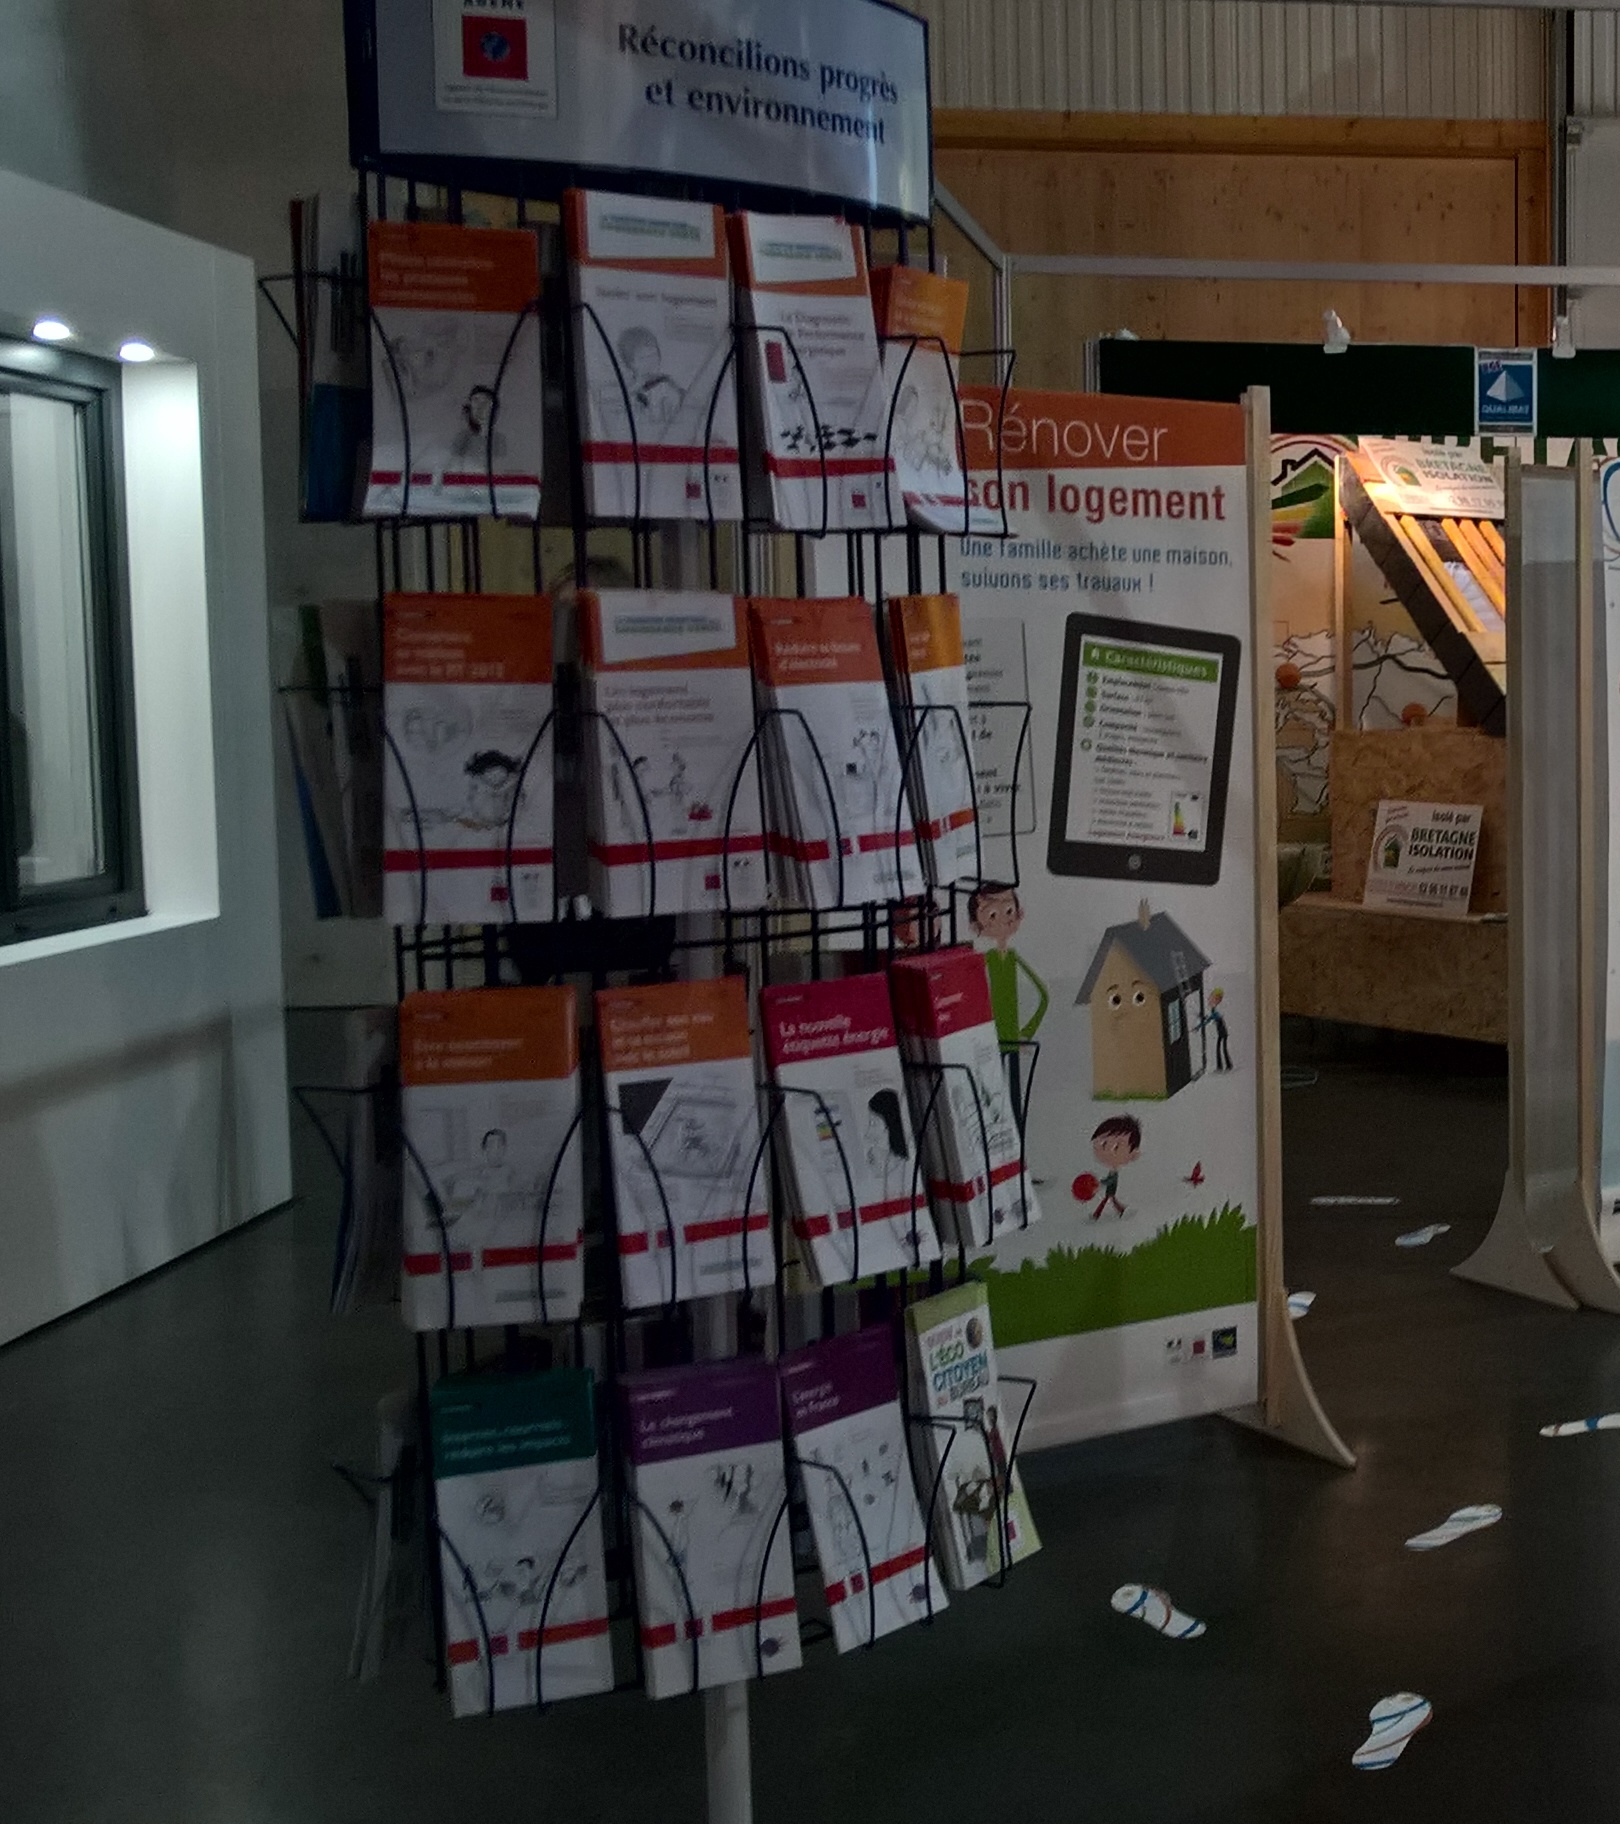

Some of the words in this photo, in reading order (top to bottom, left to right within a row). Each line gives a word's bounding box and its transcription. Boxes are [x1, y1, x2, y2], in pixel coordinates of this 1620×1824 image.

[617, 23, 811, 82] Réconcilions
[819, 60, 898, 105] progrès
[645, 79, 676, 107] et
[687, 86, 886, 145] environnement
[959, 399, 1169, 462] Rénover
[967, 477, 1031, 512] son
[1047, 474, 1227, 525] logement
[960, 535, 993, 559] Une
[1000, 537, 1062, 561] famille
[1068, 538, 1128, 563] achète
[1132, 547, 1161, 565] une
[1165, 548, 1233, 569] maison,
[960, 569, 1032, 592] suivons
[1038, 573, 1070, 591] ses
[1076, 570, 1143, 593] travaux
[1105, 650, 1208, 678] Caractéristiques
[1408, 845, 1475, 861] ISOLATION
[1411, 827, 1478, 847] BRETAGNE
